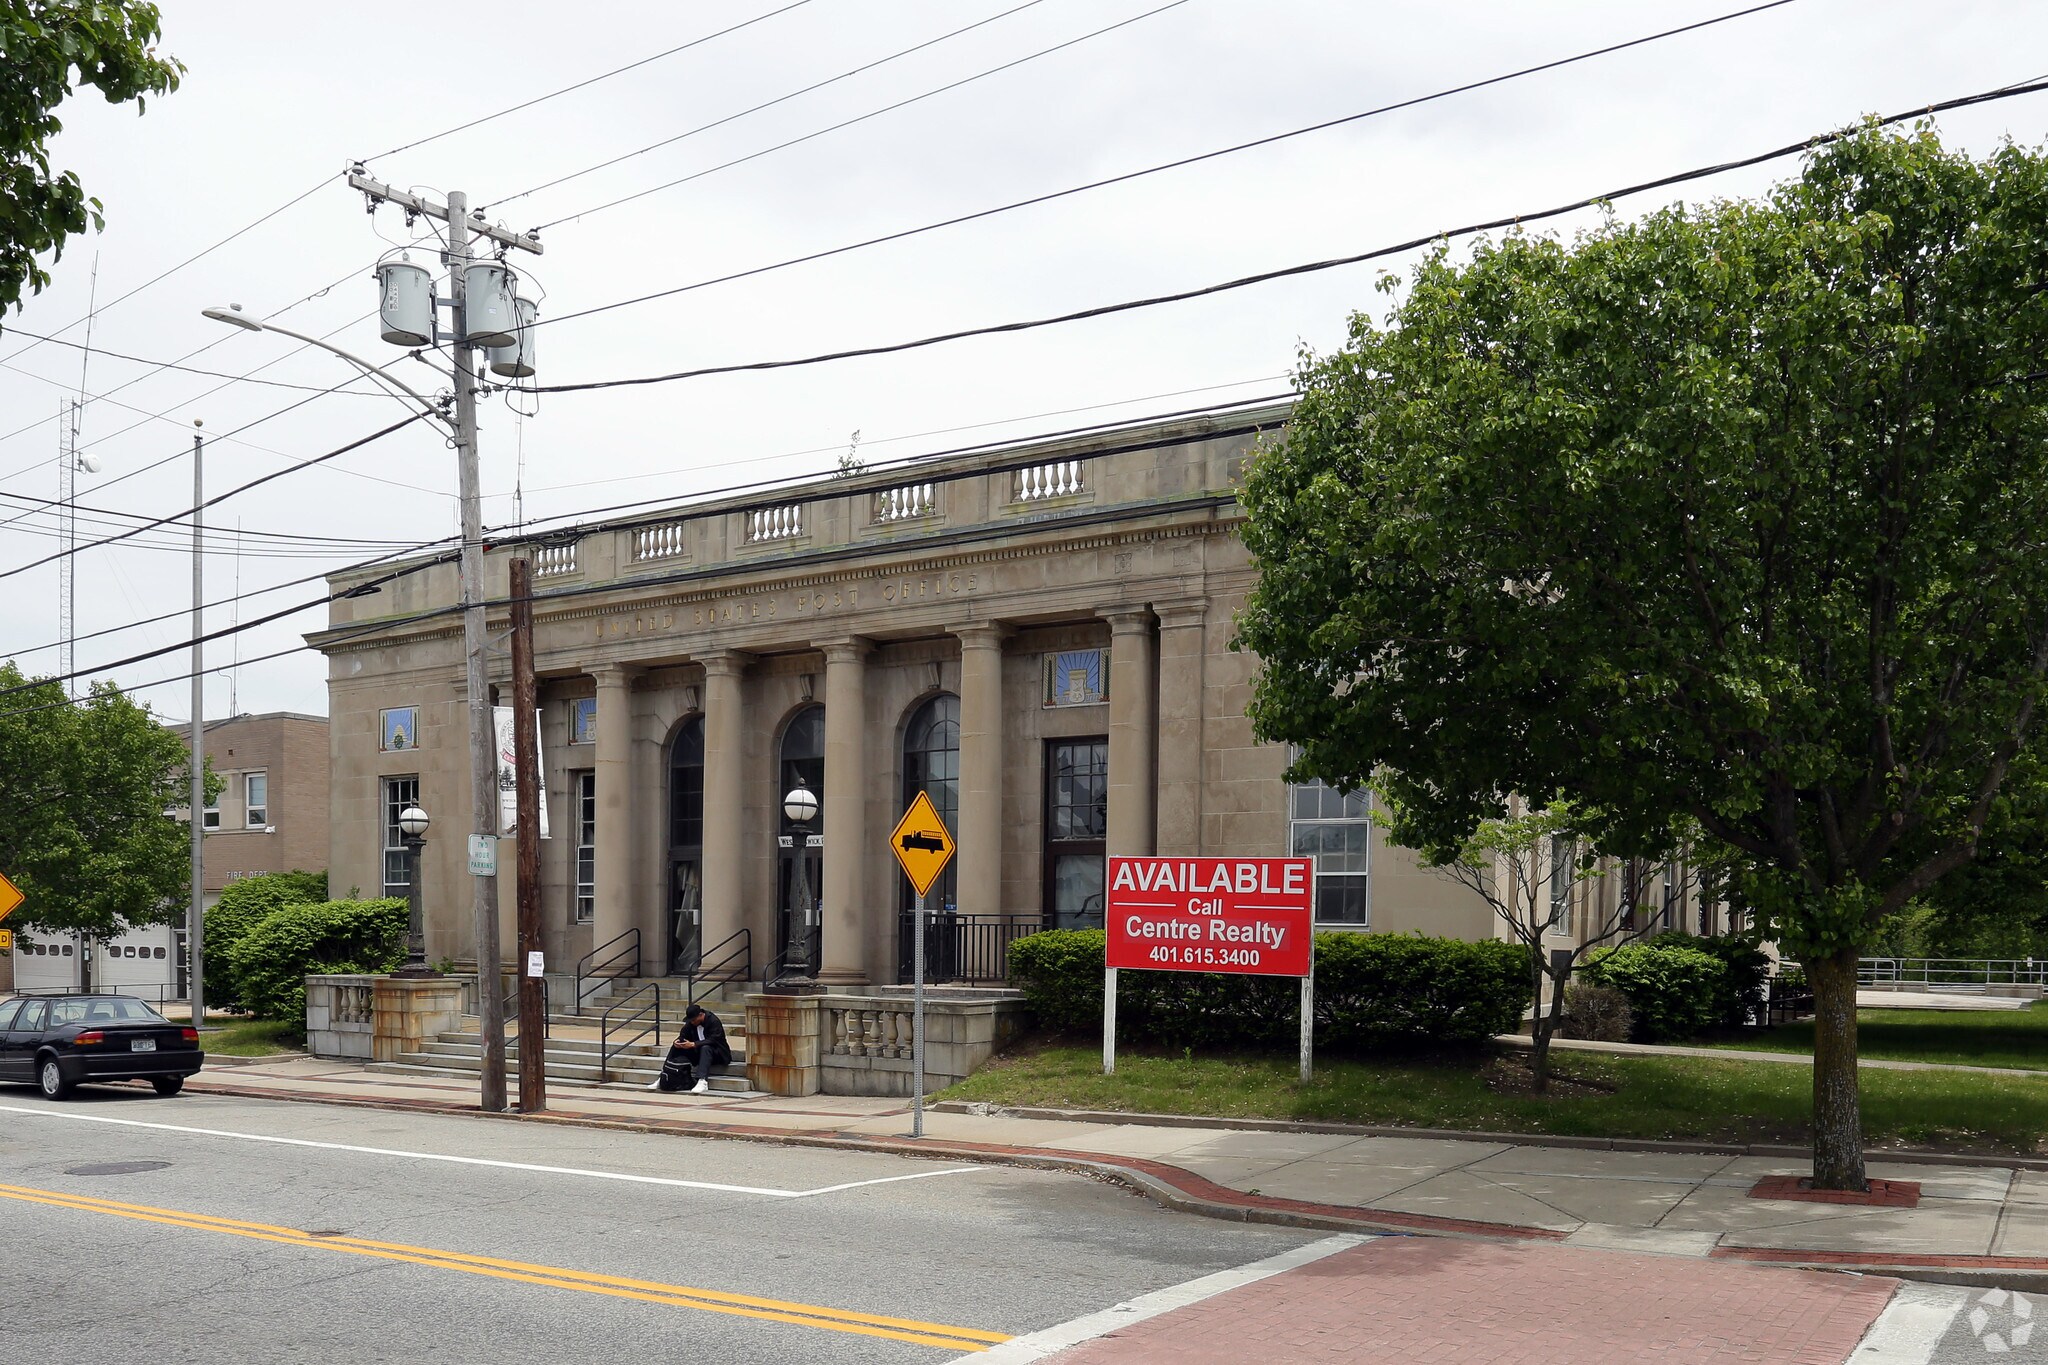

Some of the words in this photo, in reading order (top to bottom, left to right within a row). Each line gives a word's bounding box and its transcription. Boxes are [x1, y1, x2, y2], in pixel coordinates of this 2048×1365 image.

[597, 615, 673, 638] UNITED
[695, 599, 777, 626] STATES
[798, 589, 858, 611] POST
[883, 575, 977, 601] OFFICE
[478, 841, 488, 849] TWO
[475, 851, 489, 859] HOUR
[471, 861, 493, 869] PARKING
[226, 871, 243, 879] FIRE
[1112, 862, 1305, 894] AVAILABLE
[1187, 898, 1222, 916] Call
[1126, 916, 1201, 941] Centre
[1209, 919, 1286, 950] Realty
[1149, 946, 1260, 966] 401.615.3400
